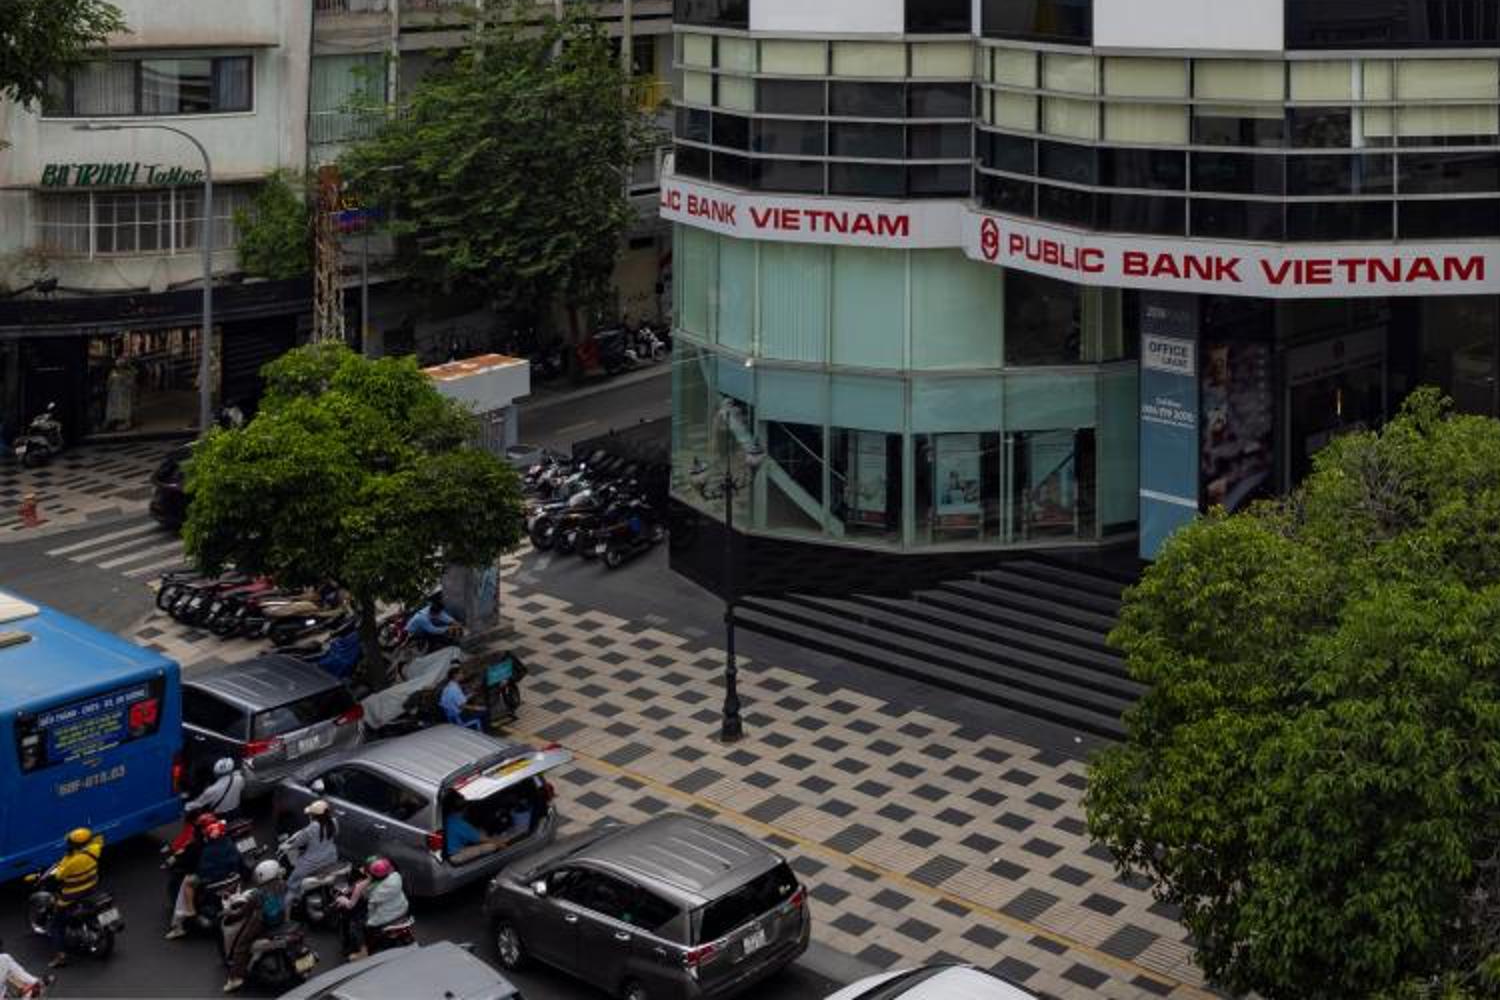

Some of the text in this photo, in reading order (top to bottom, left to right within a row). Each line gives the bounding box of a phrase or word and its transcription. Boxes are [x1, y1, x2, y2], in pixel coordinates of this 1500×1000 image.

[687, 194, 736, 226] BANK
[749, 206, 909, 237] VIETNAM
[1009, 233, 1486, 285] PUBLIC BANK VIETNAM
[1148, 342, 1189, 358] OFFICE
